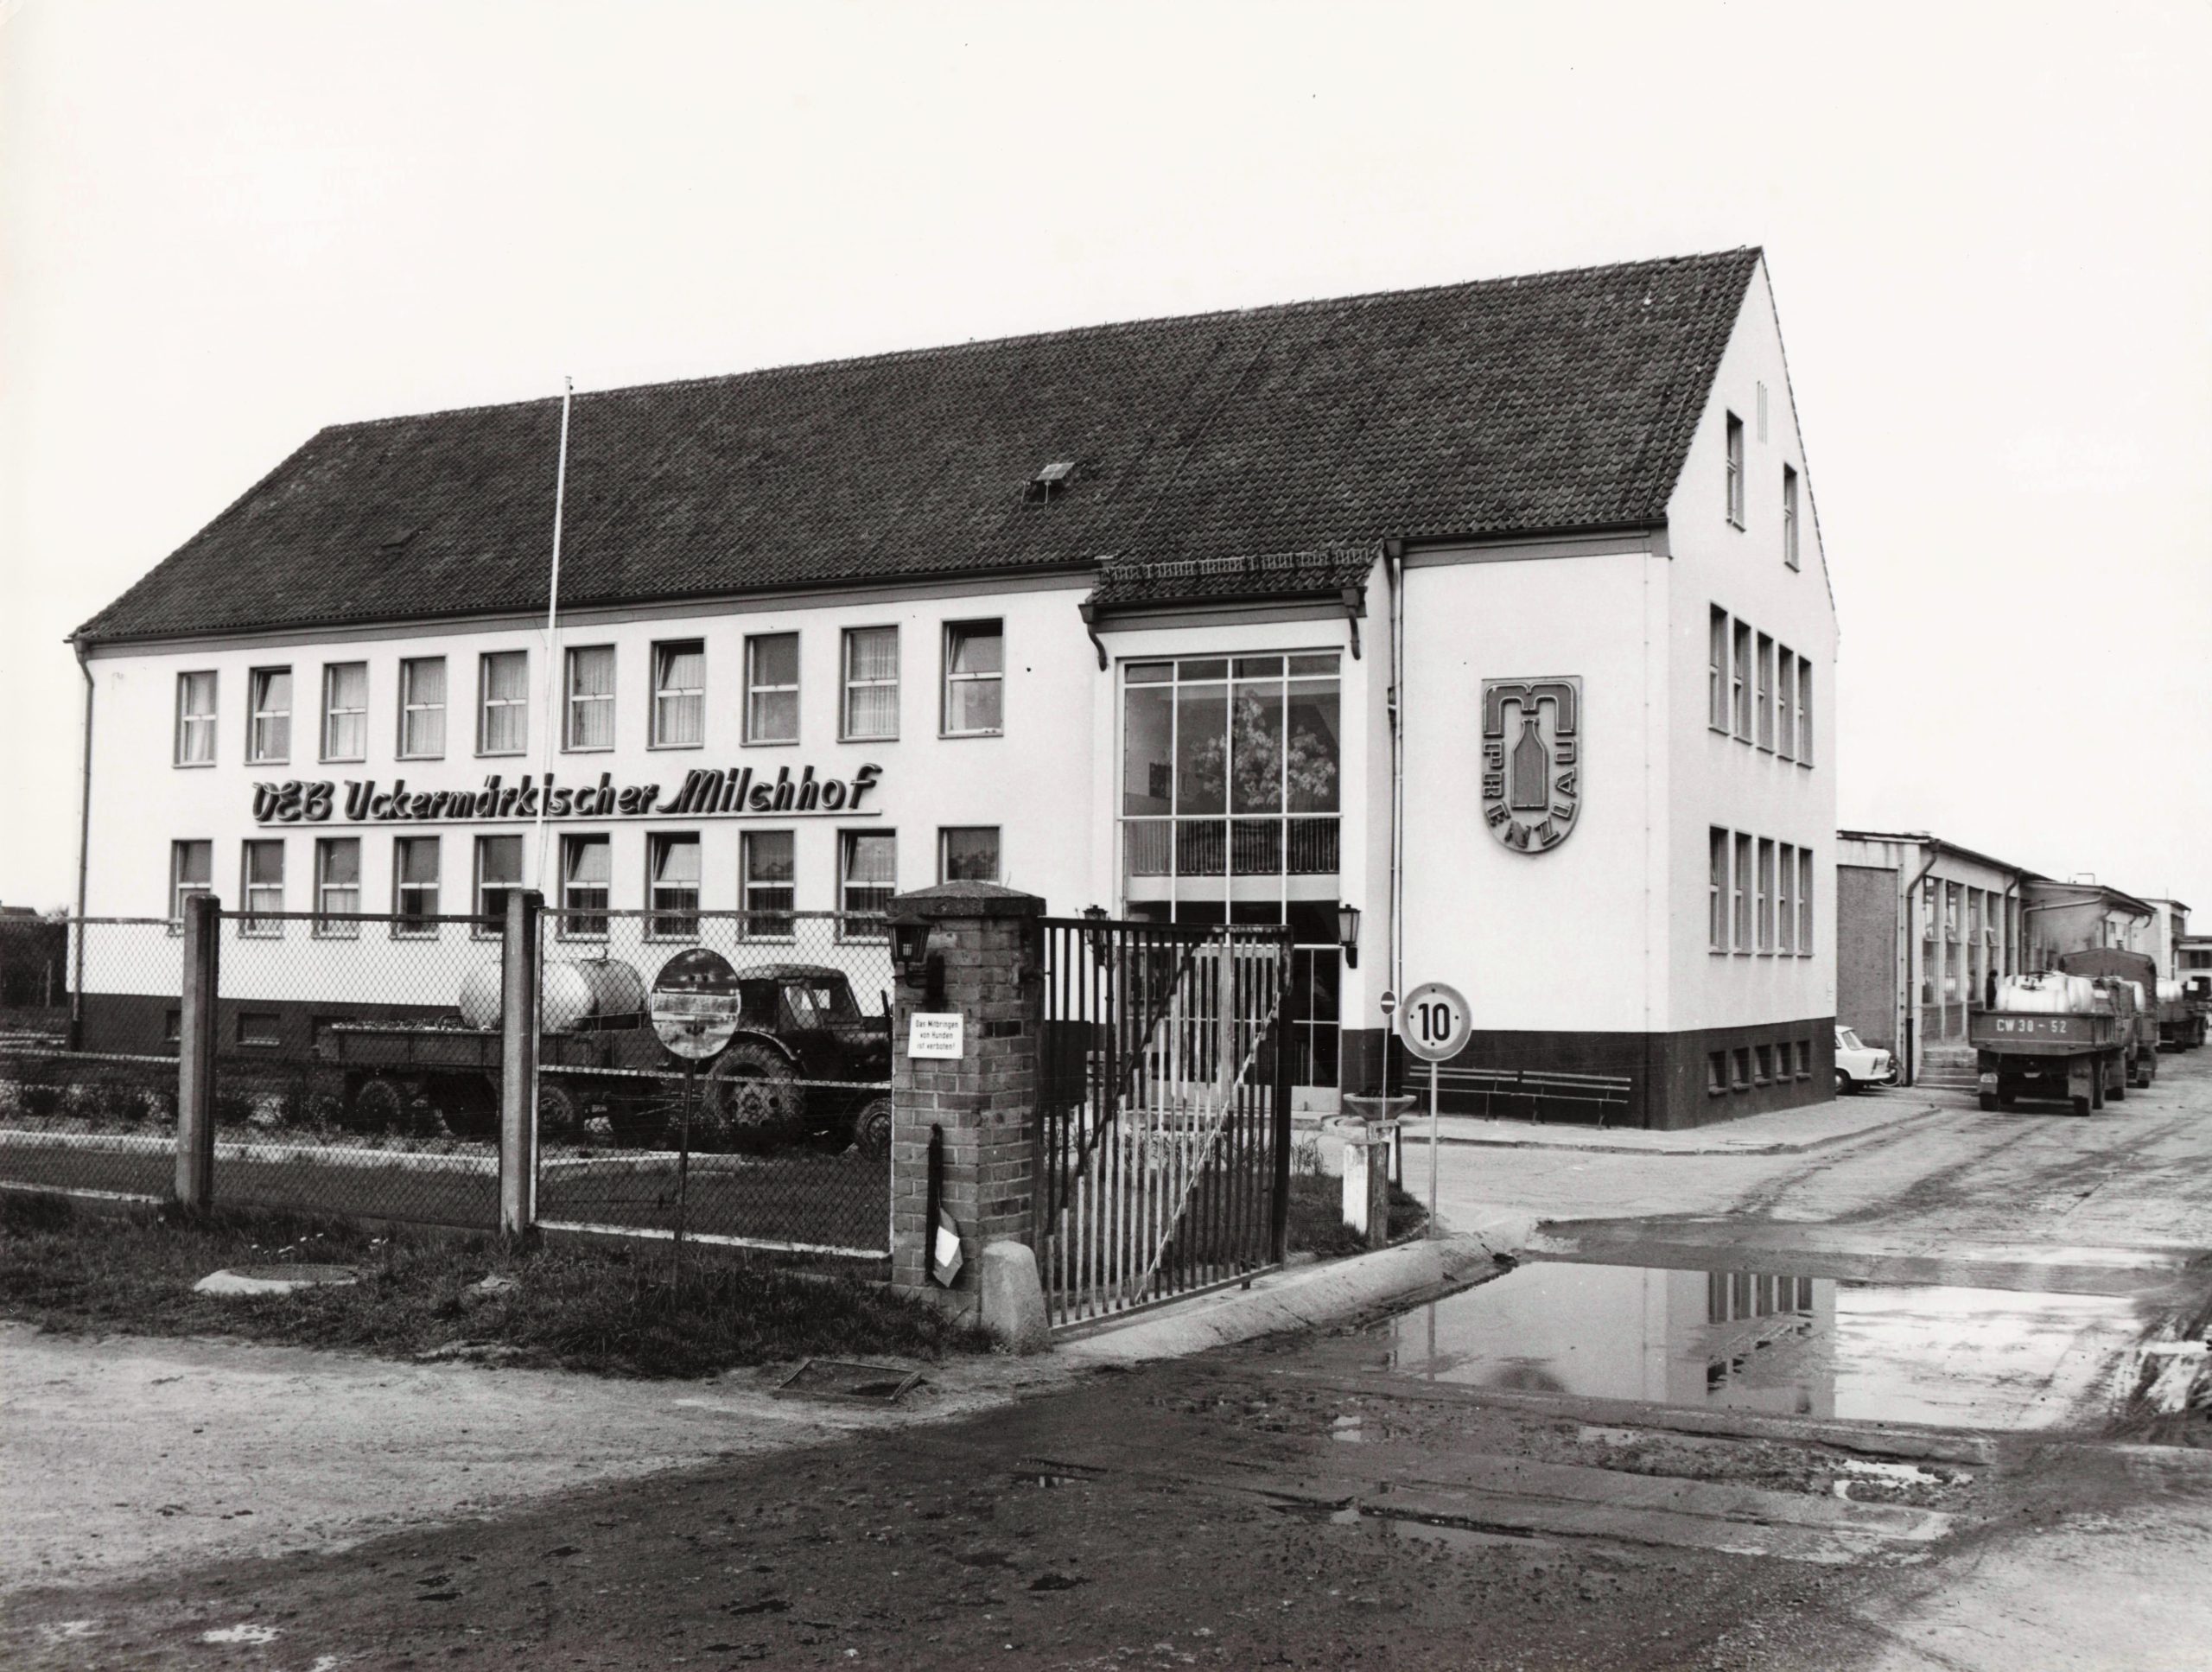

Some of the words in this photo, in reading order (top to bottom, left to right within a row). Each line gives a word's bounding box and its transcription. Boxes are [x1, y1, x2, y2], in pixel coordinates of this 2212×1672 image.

[252, 779, 335, 821] VEB
[343, 772, 661, 820] Uckermärkischer
[656, 763, 883, 814] Milchhof
[1483, 740, 1577, 849] PRENZLAU
[928, 1020, 959, 1030] Mitbringen
[931, 1031, 953, 1039] Hunden
[1418, 1003, 1450, 1041] 10
